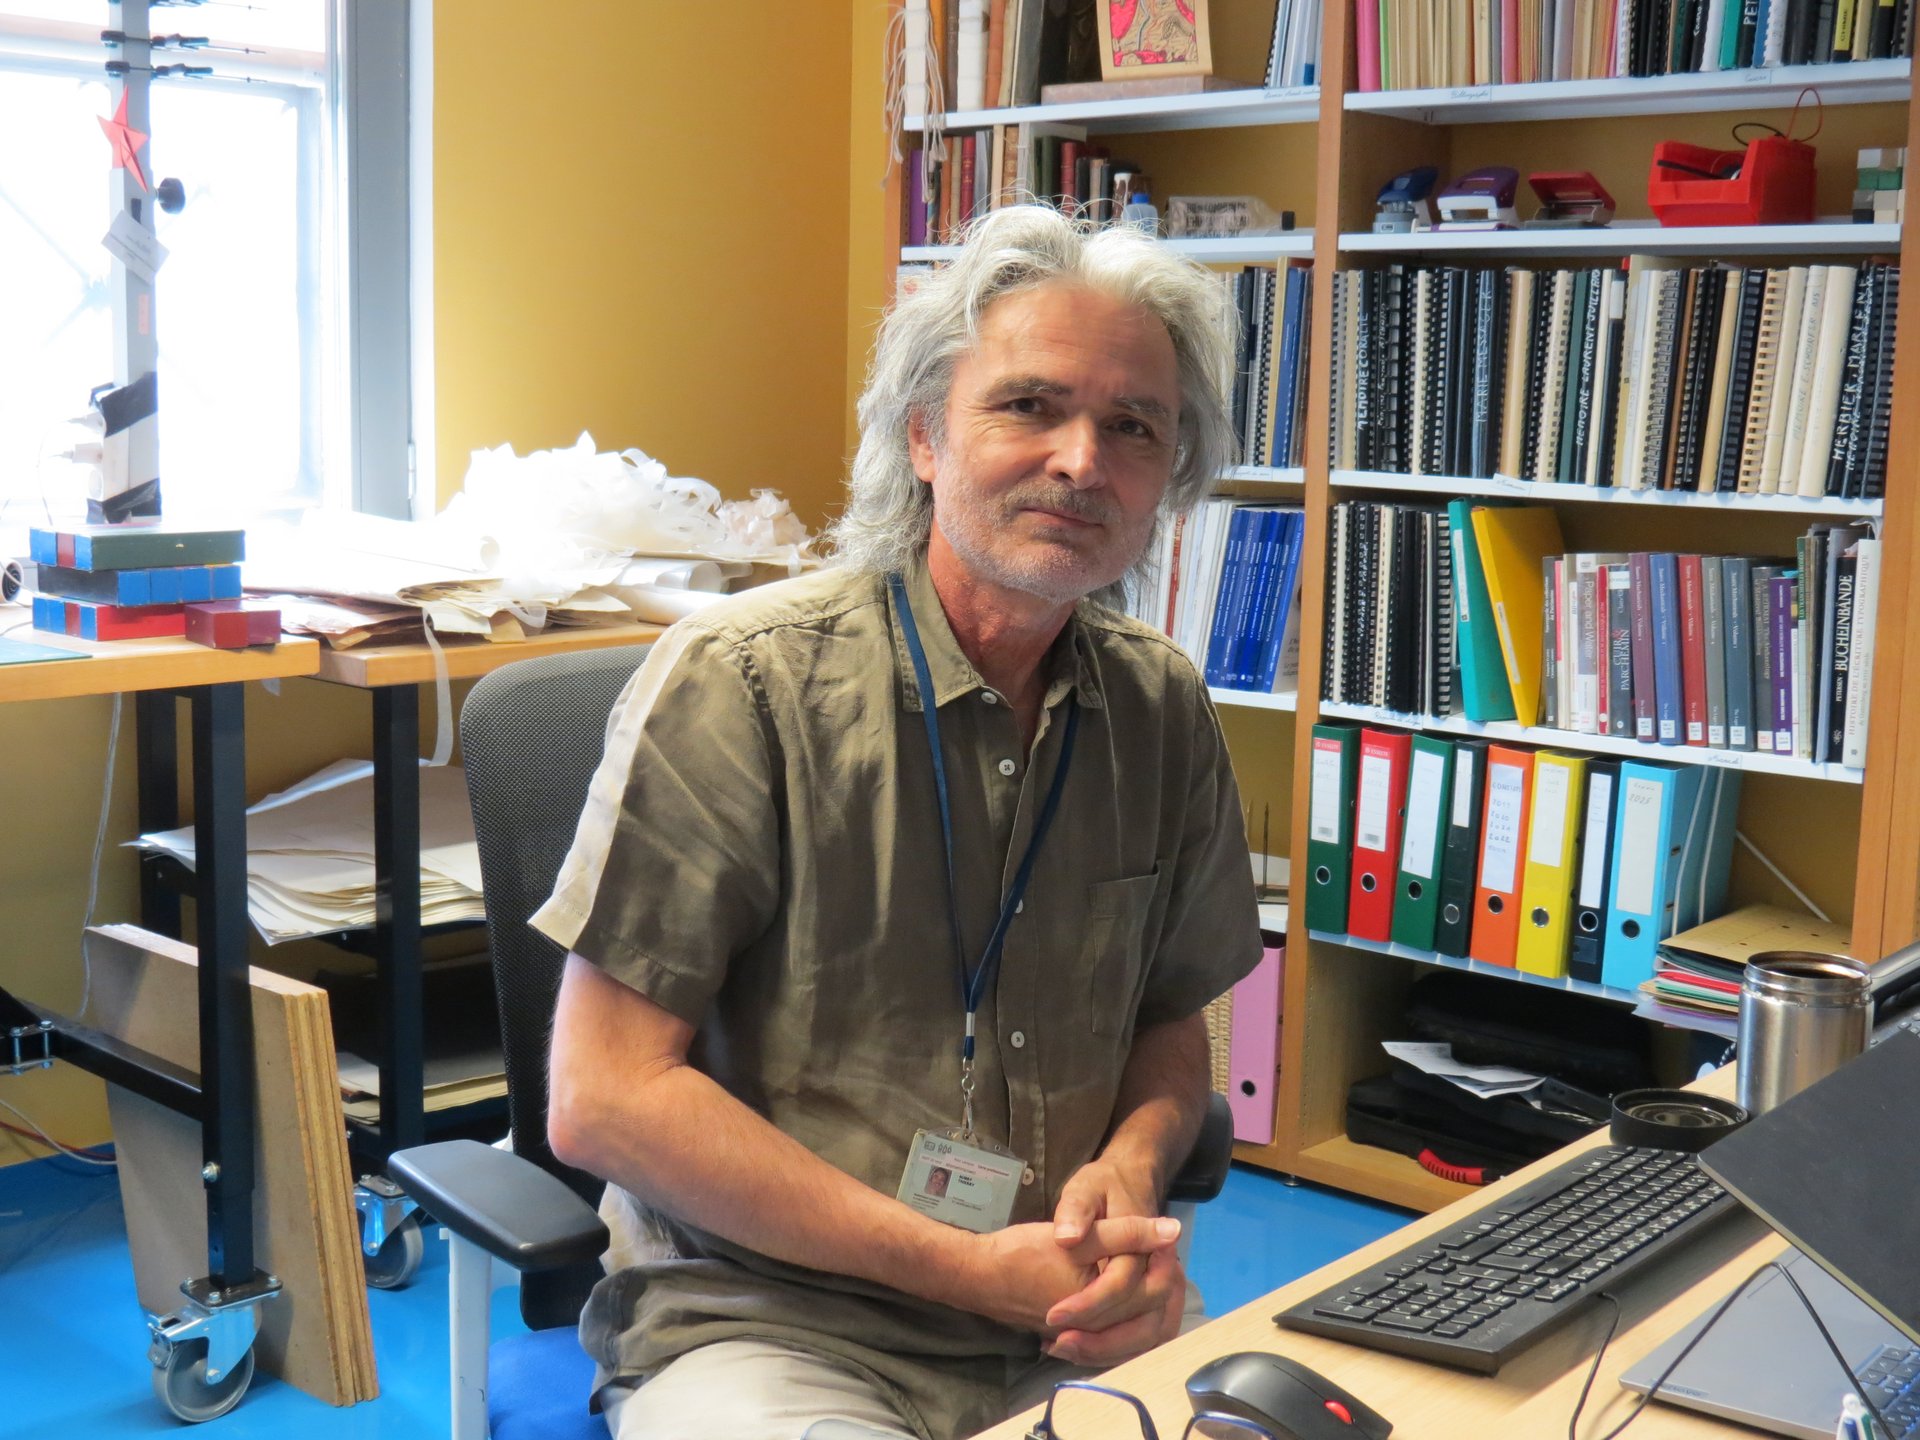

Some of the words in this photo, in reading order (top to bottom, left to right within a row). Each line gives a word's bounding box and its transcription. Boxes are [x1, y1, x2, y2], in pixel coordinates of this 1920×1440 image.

[1846, 275, 1867, 368] MARLENE
[1581, 325, 1595, 382] LAURENT
[1475, 373, 1488, 423] MARIE
[1575, 388, 1590, 446] MEMOIRE
[1583, 580, 1594, 608] Paper
[1856, 556, 1869, 626] TYPOGRAPHIQUE
[1585, 611, 1595, 630] and
[1835, 574, 1853, 671] BUCHEINBÄNDE
[1585, 631, 1596, 658] Water
[1613, 639, 1622, 666] CUIR
[1620, 629, 1630, 690] PARCHEMIN
[1835, 676, 1844, 702] PETERSEN
[1850, 680, 1859, 693] DE
[1848, 695, 1859, 736] HISTOIRE
